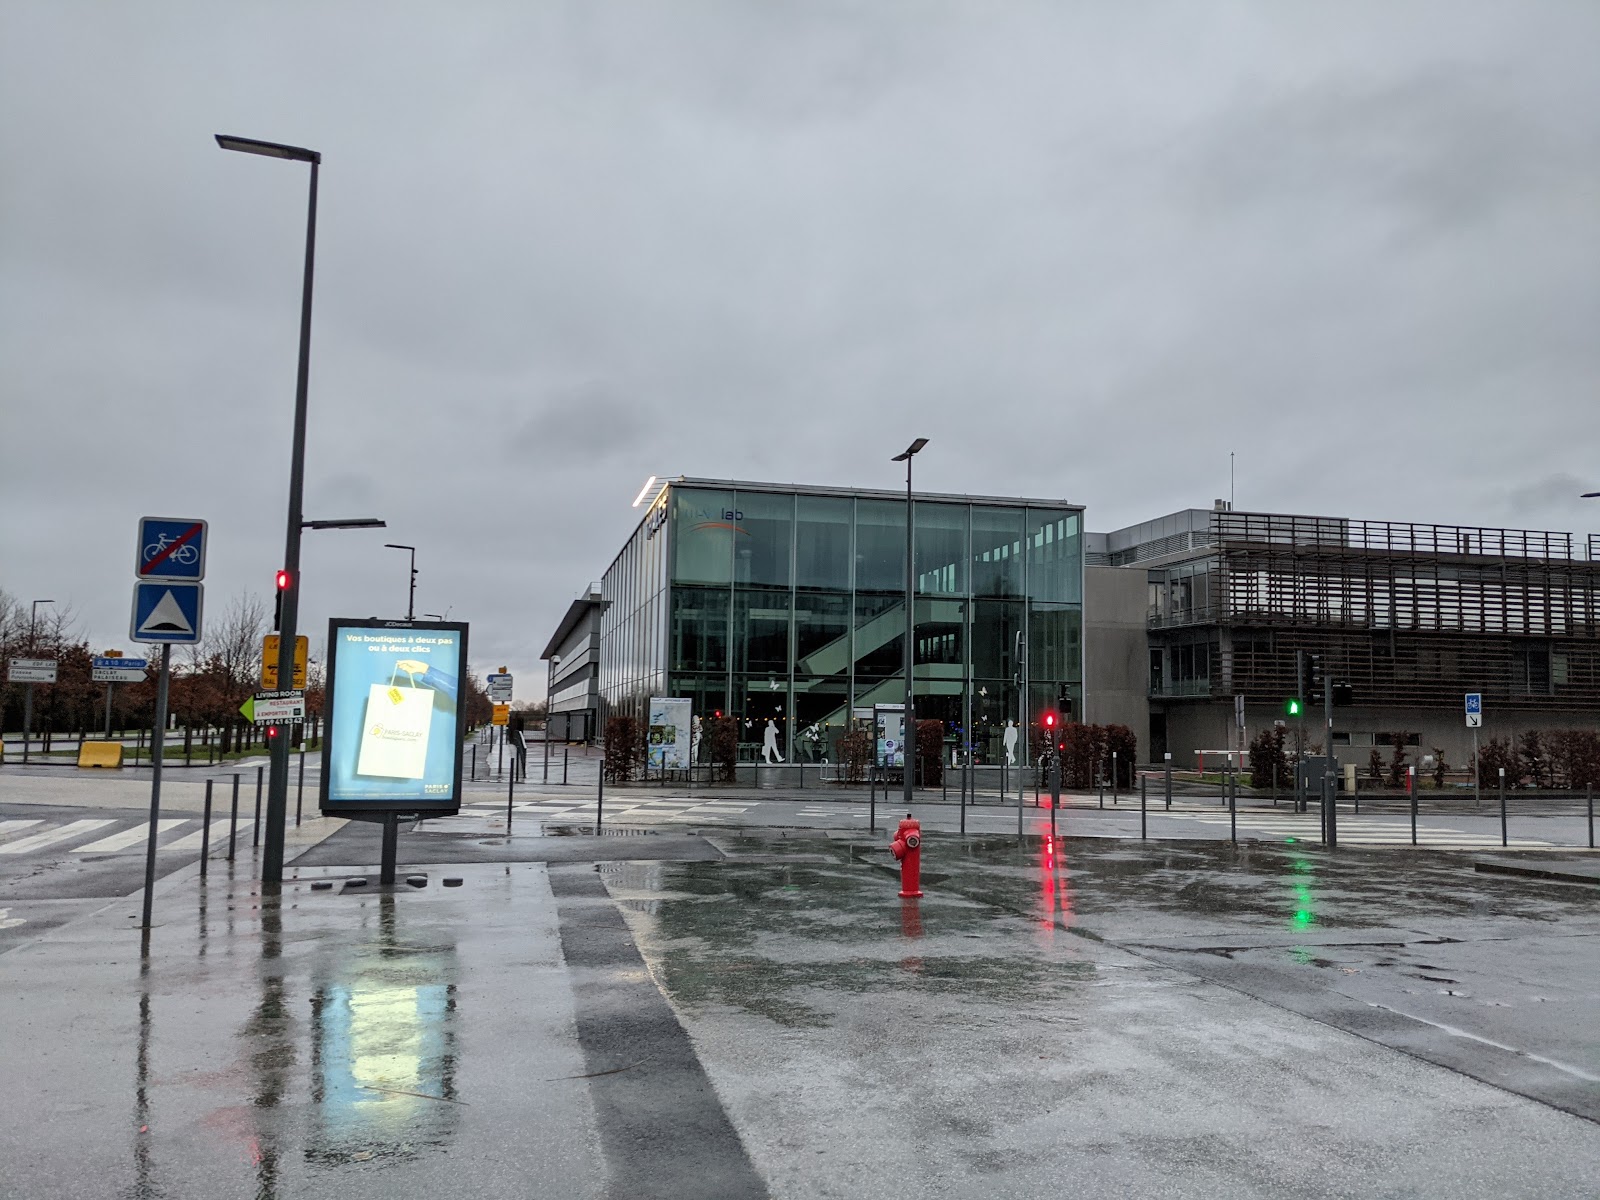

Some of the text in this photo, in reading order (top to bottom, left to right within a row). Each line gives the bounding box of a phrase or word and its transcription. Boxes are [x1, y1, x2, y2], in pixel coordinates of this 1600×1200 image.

[721, 508, 744, 520] lab
[364, 635, 406, 644] boutiques
[389, 644, 410, 652] deux
